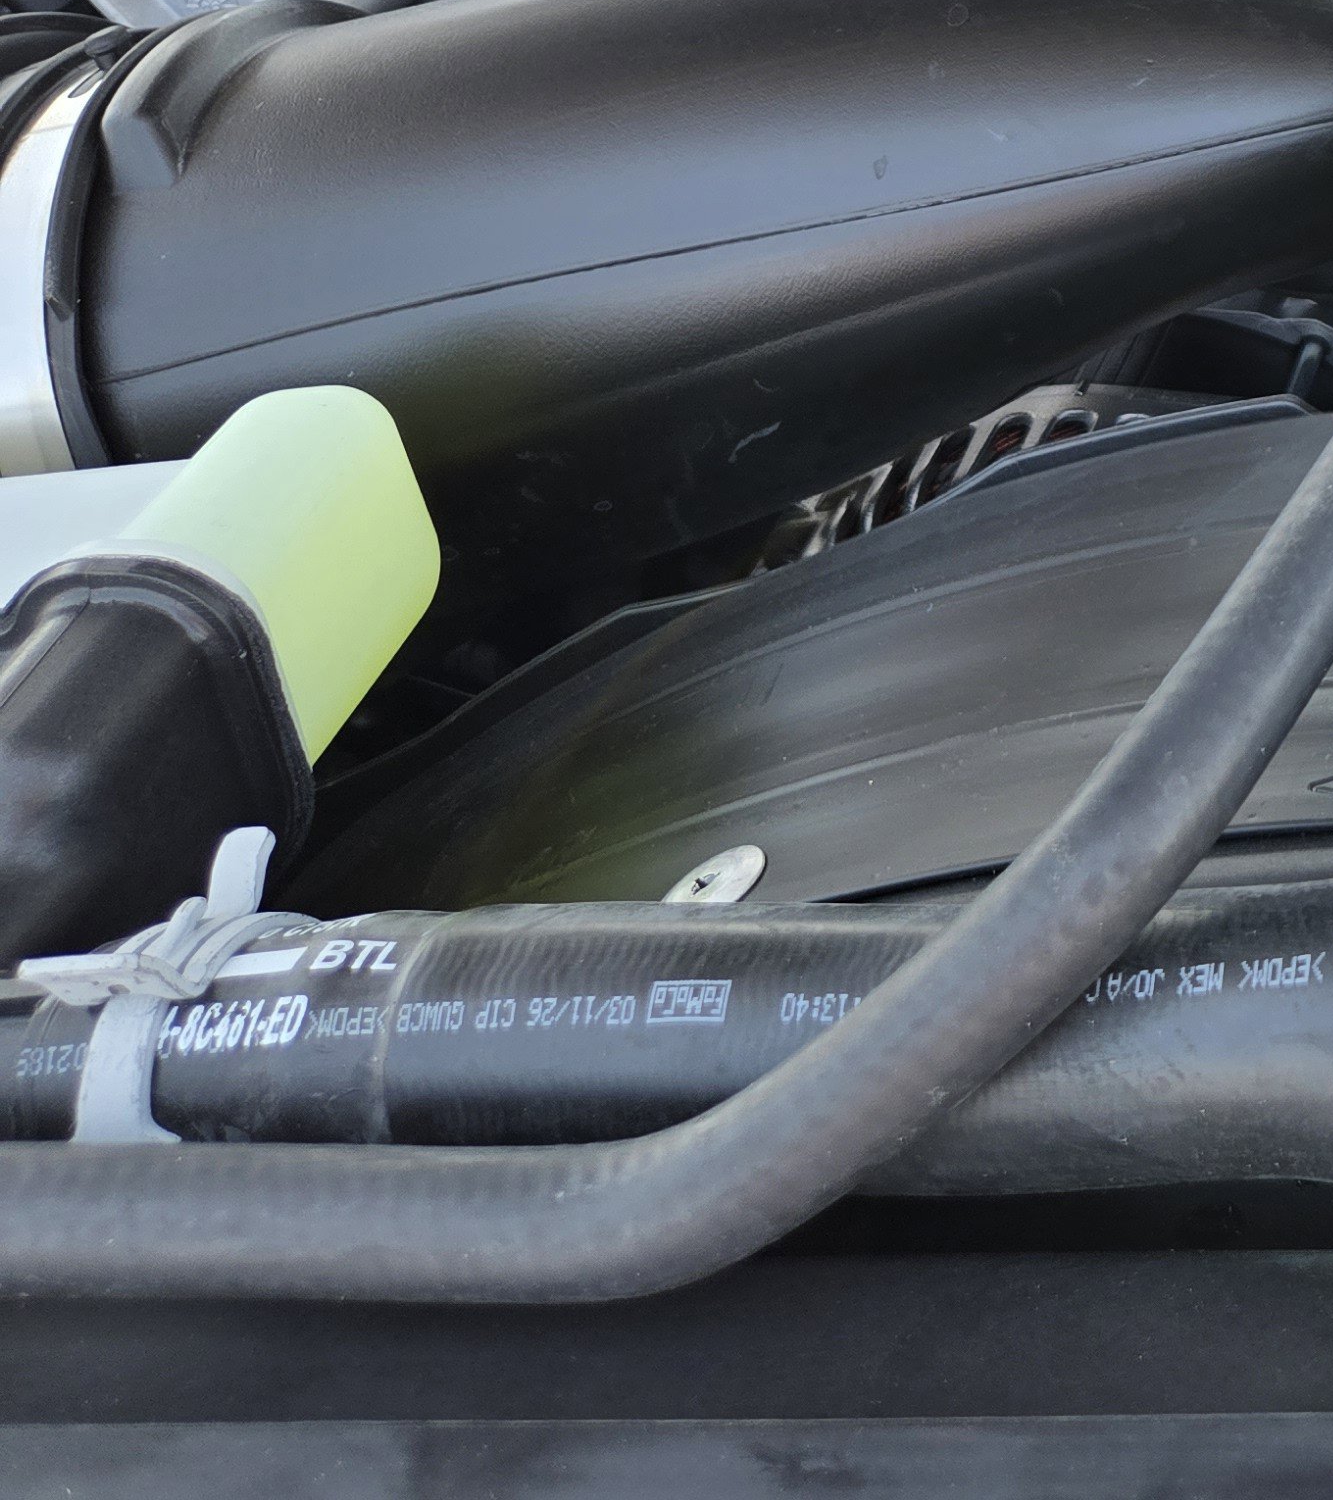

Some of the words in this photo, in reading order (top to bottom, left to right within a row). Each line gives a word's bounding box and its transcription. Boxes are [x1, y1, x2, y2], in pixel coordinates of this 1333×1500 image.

[310, 940, 397, 970] BTL
[1176, 961, 1225, 996] MEX
[474, 997, 517, 1031] CIP
[526, 994, 636, 1028] 03/11/26
